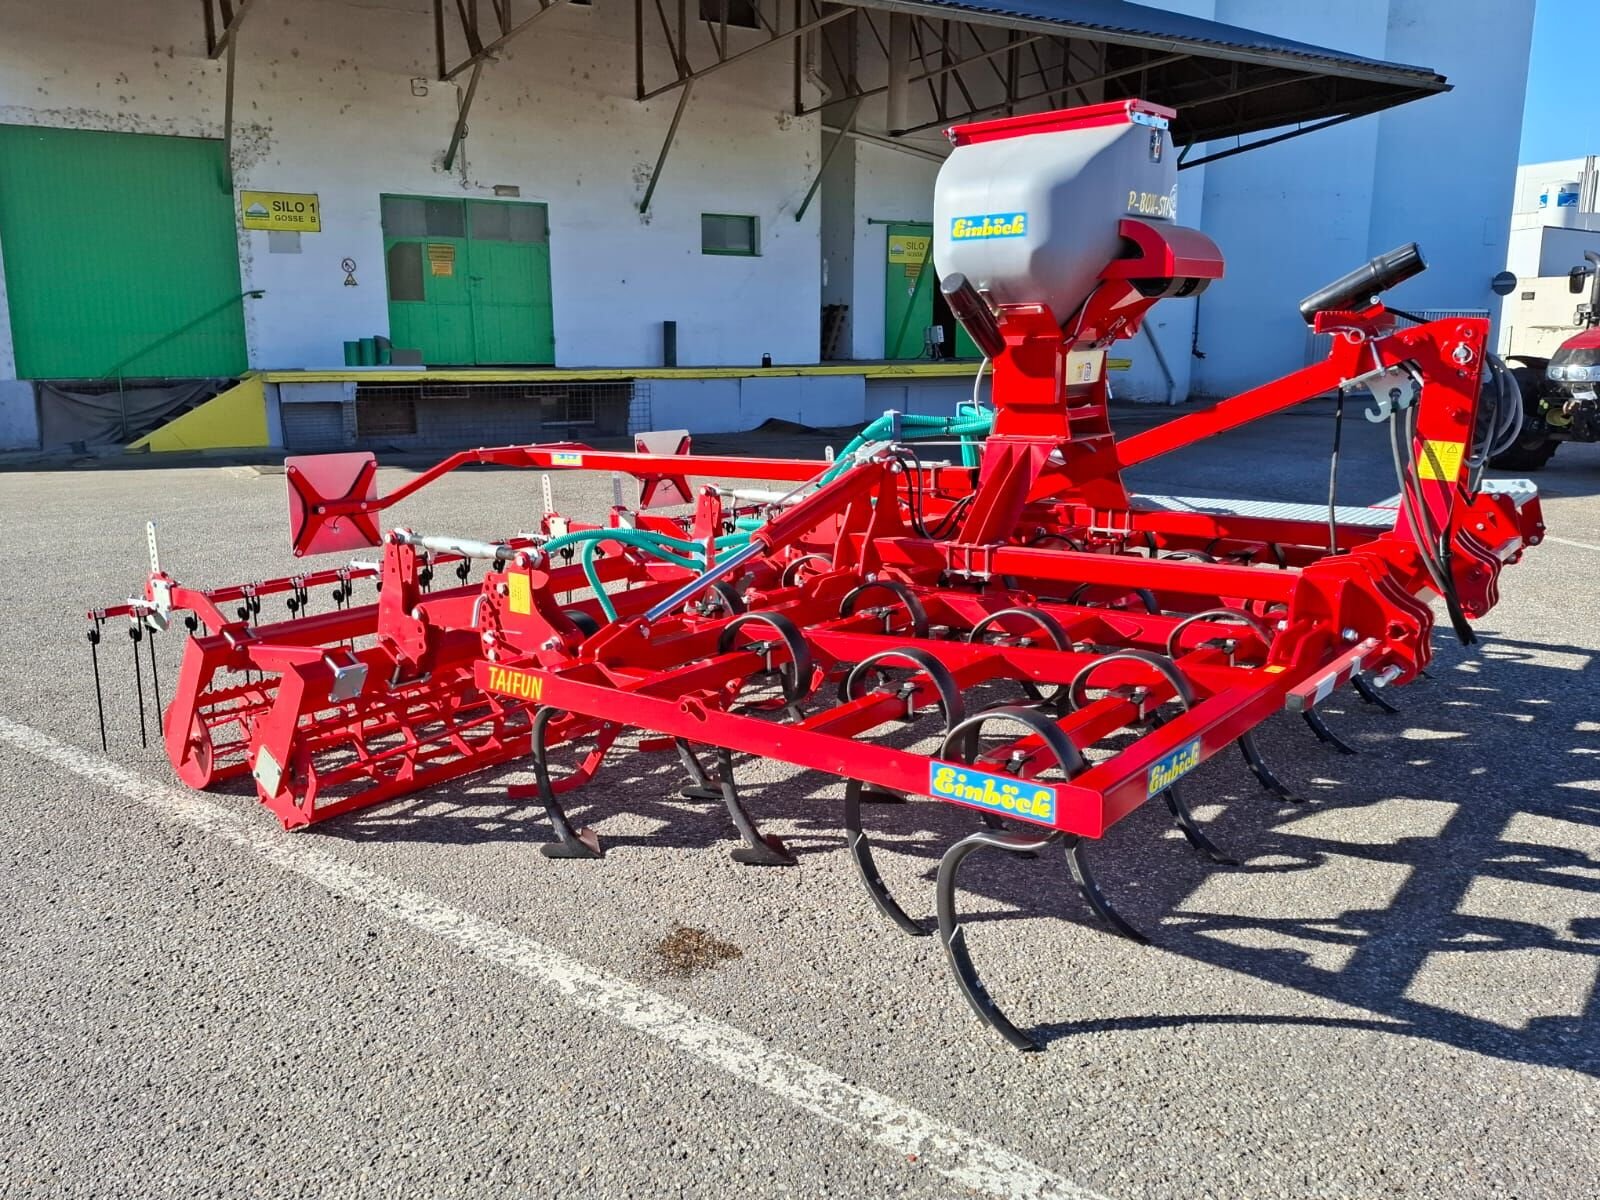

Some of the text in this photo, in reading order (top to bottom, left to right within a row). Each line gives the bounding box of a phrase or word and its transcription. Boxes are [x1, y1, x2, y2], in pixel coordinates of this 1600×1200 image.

[272, 200, 316, 213] SILO 1
[274, 214, 304, 223] GOSSE
[952, 214, 1025, 238] Einböck
[905, 241, 925, 251] SILO
[488, 665, 543, 700] TAIFUN
[1149, 741, 1200, 793] Einböck
[933, 767, 1051, 818] Einböck
